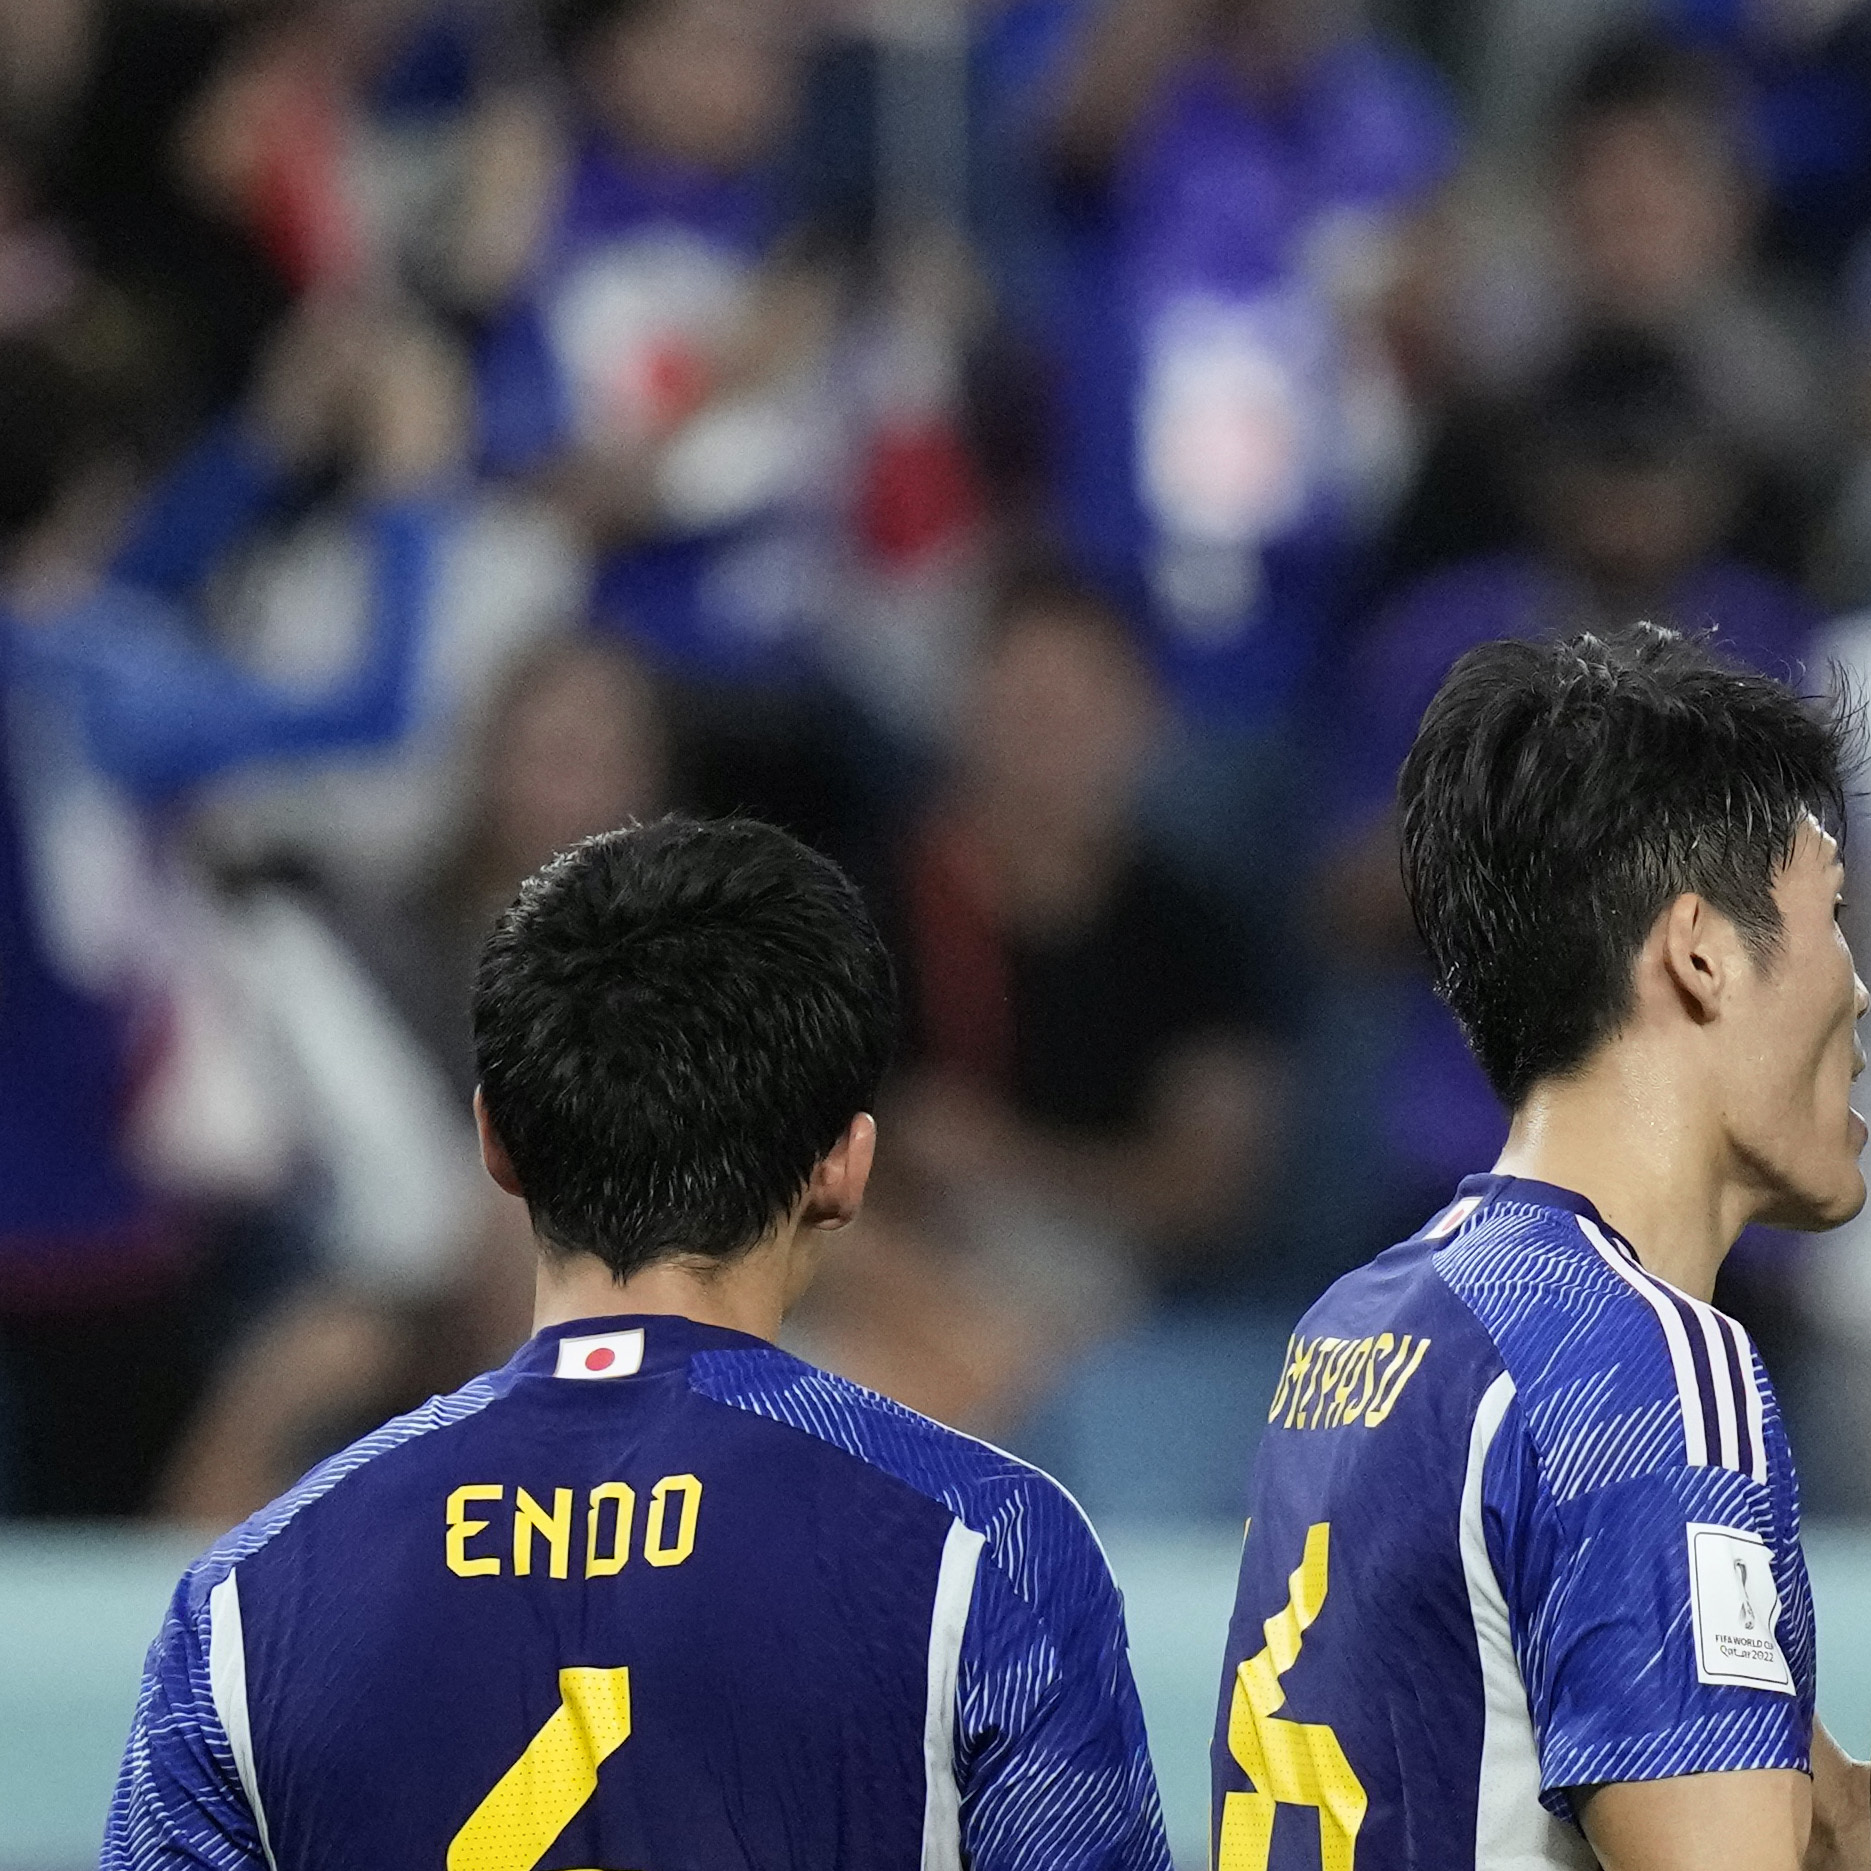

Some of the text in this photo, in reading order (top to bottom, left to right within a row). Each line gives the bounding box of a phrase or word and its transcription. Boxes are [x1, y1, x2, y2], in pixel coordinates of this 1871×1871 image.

[446, 1473, 703, 1579] ENDO
[1715, 1634, 1733, 1644] FIFA
[1734, 1637, 1763, 1648] WORLD
[1719, 1644, 1774, 1662] Qatar 2022
